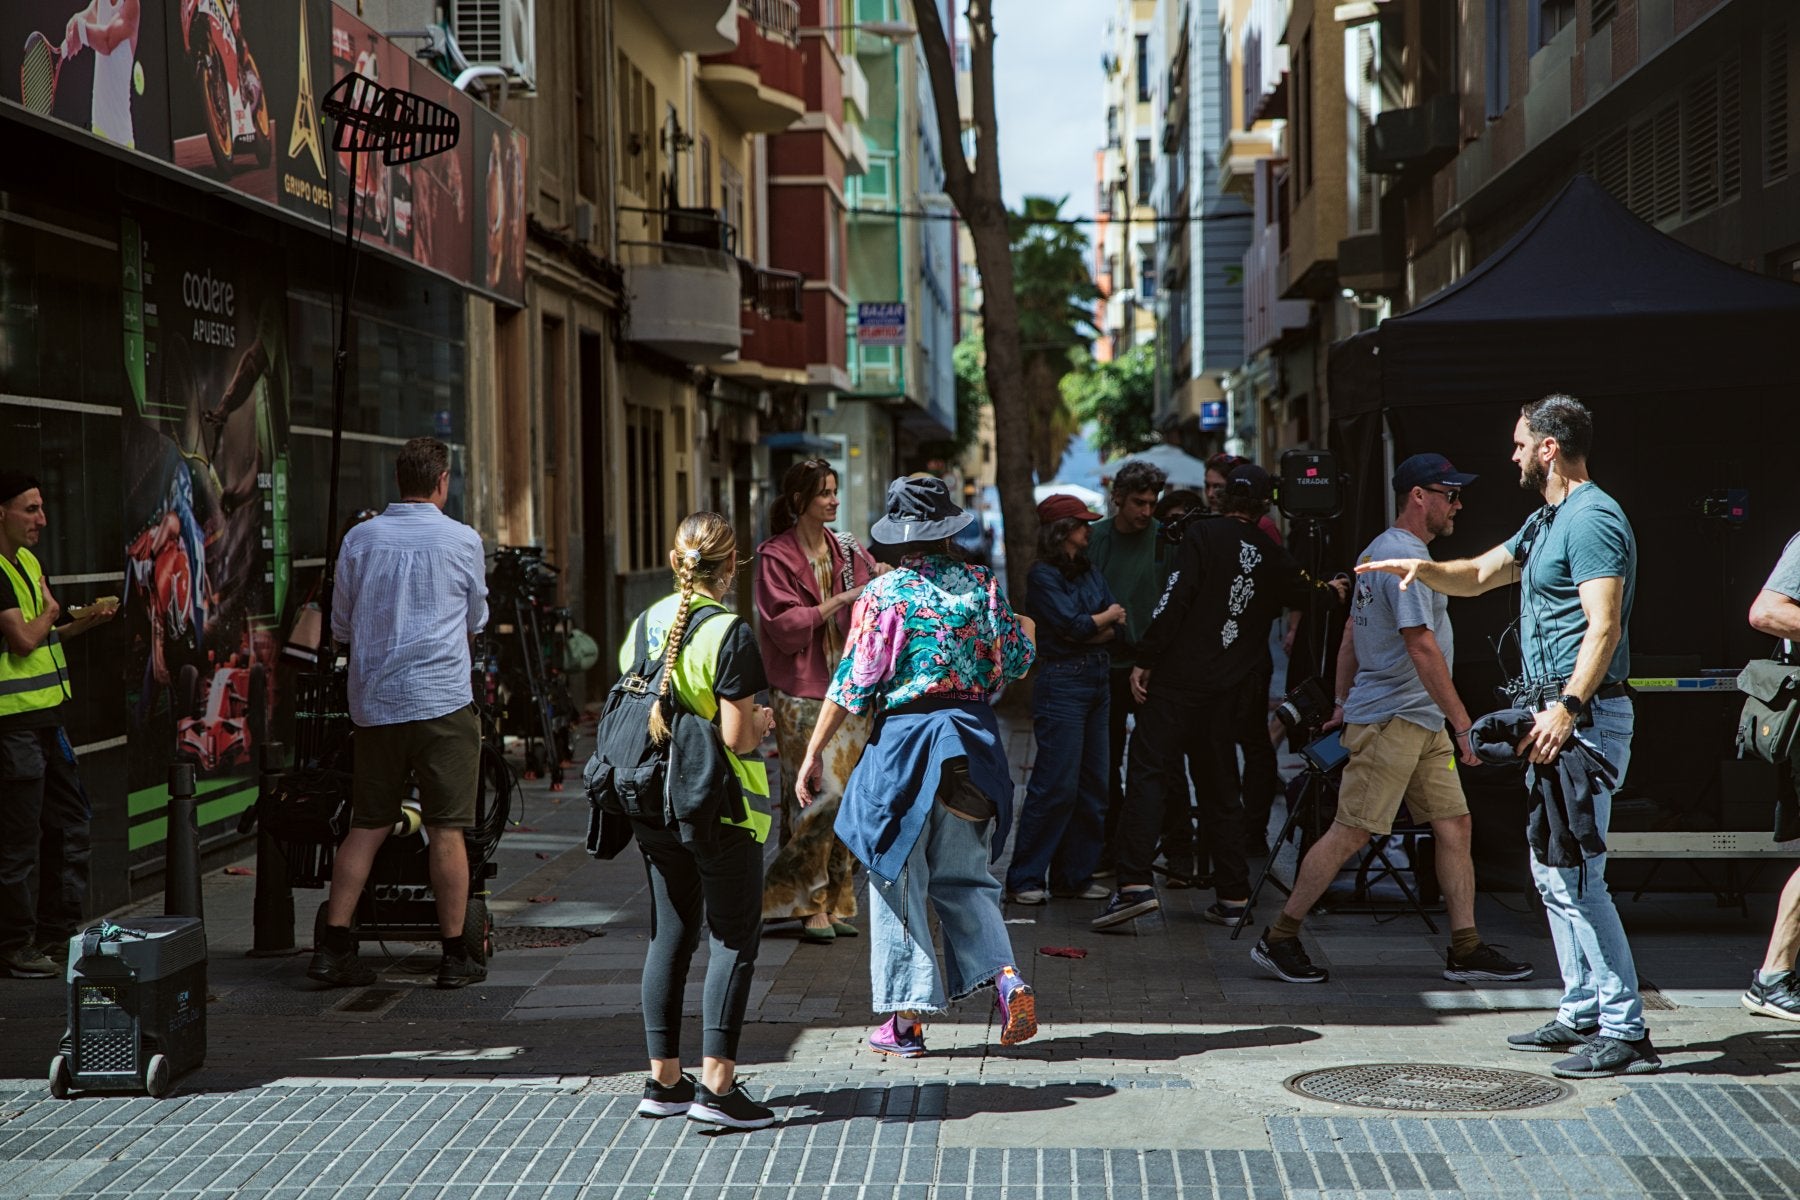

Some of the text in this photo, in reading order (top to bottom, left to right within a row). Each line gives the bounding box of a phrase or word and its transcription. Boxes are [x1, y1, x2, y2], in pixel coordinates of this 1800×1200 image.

[284, 172, 311, 202] GRUPO
[182, 267, 235, 318] codere
[859, 303, 904, 318] BAZAR
[192, 317, 236, 349] APUESTAS
[1296, 477, 1329, 486] TERADEK
